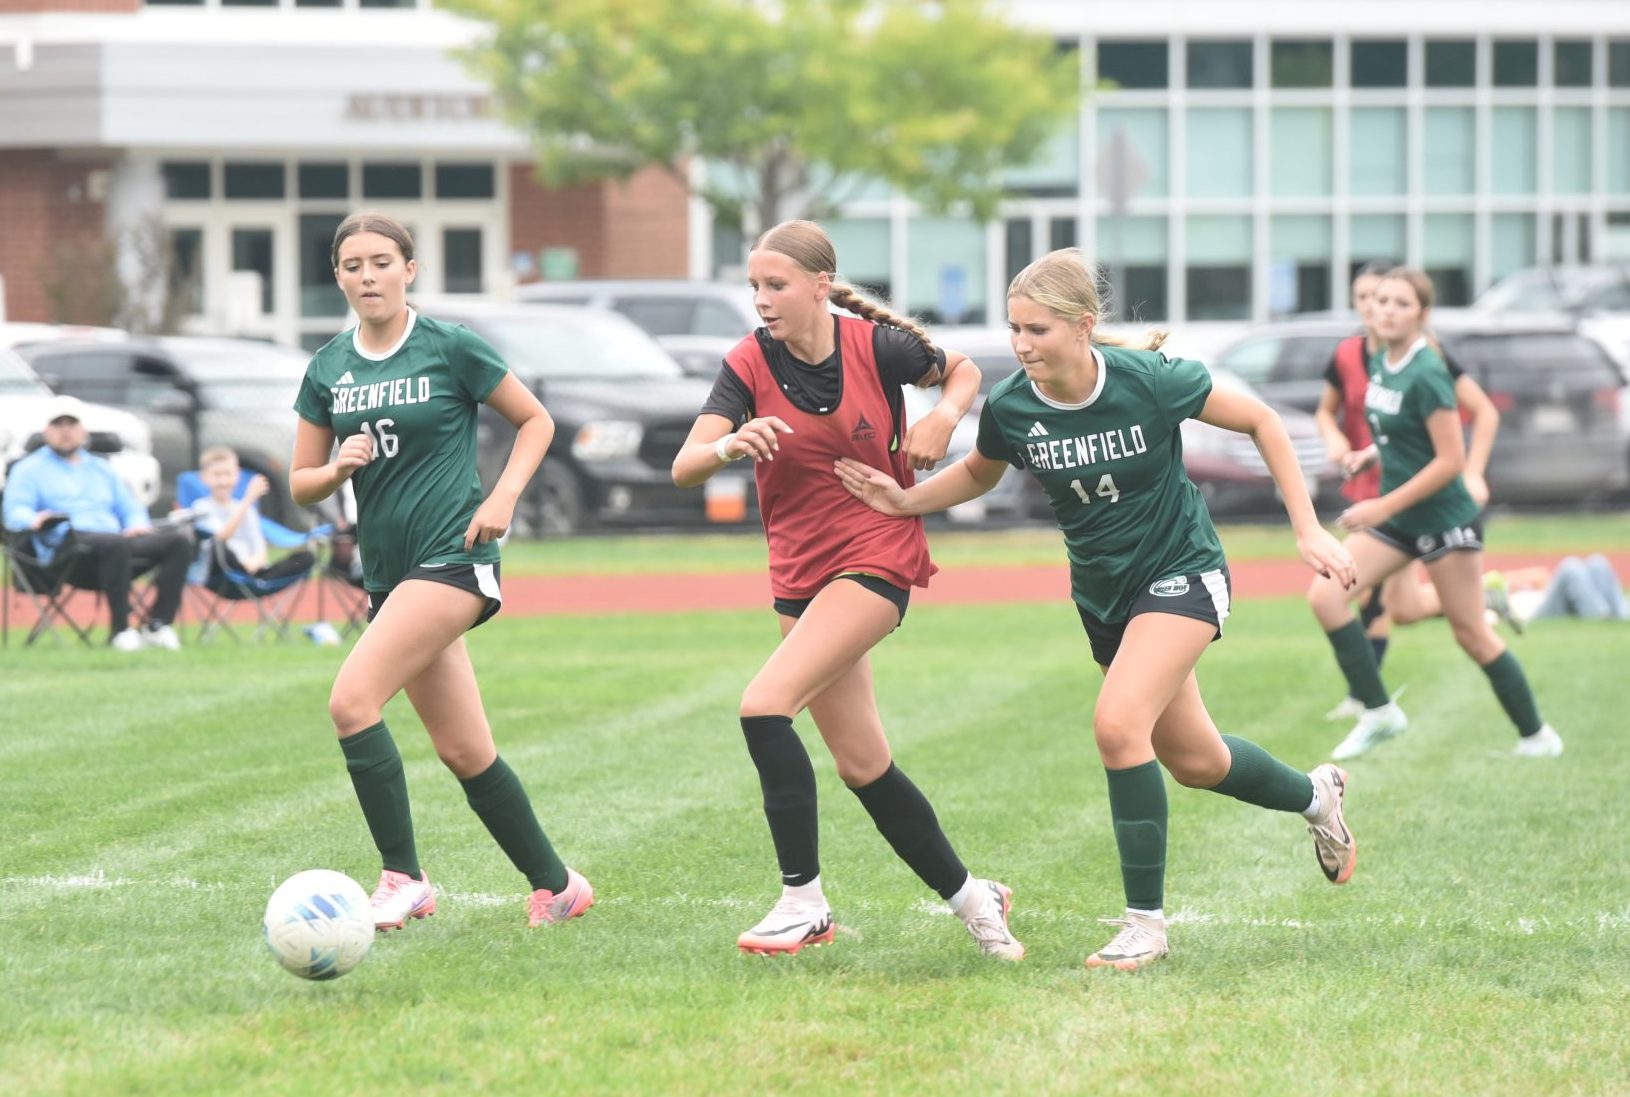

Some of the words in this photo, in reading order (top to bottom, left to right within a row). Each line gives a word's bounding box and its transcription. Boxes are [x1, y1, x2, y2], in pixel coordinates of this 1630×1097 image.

[330, 377, 430, 414] GREENFIELD
[360, 418, 399, 460] 16
[1026, 425, 1147, 470] GREENFIELD
[1070, 473, 1120, 504] 14
